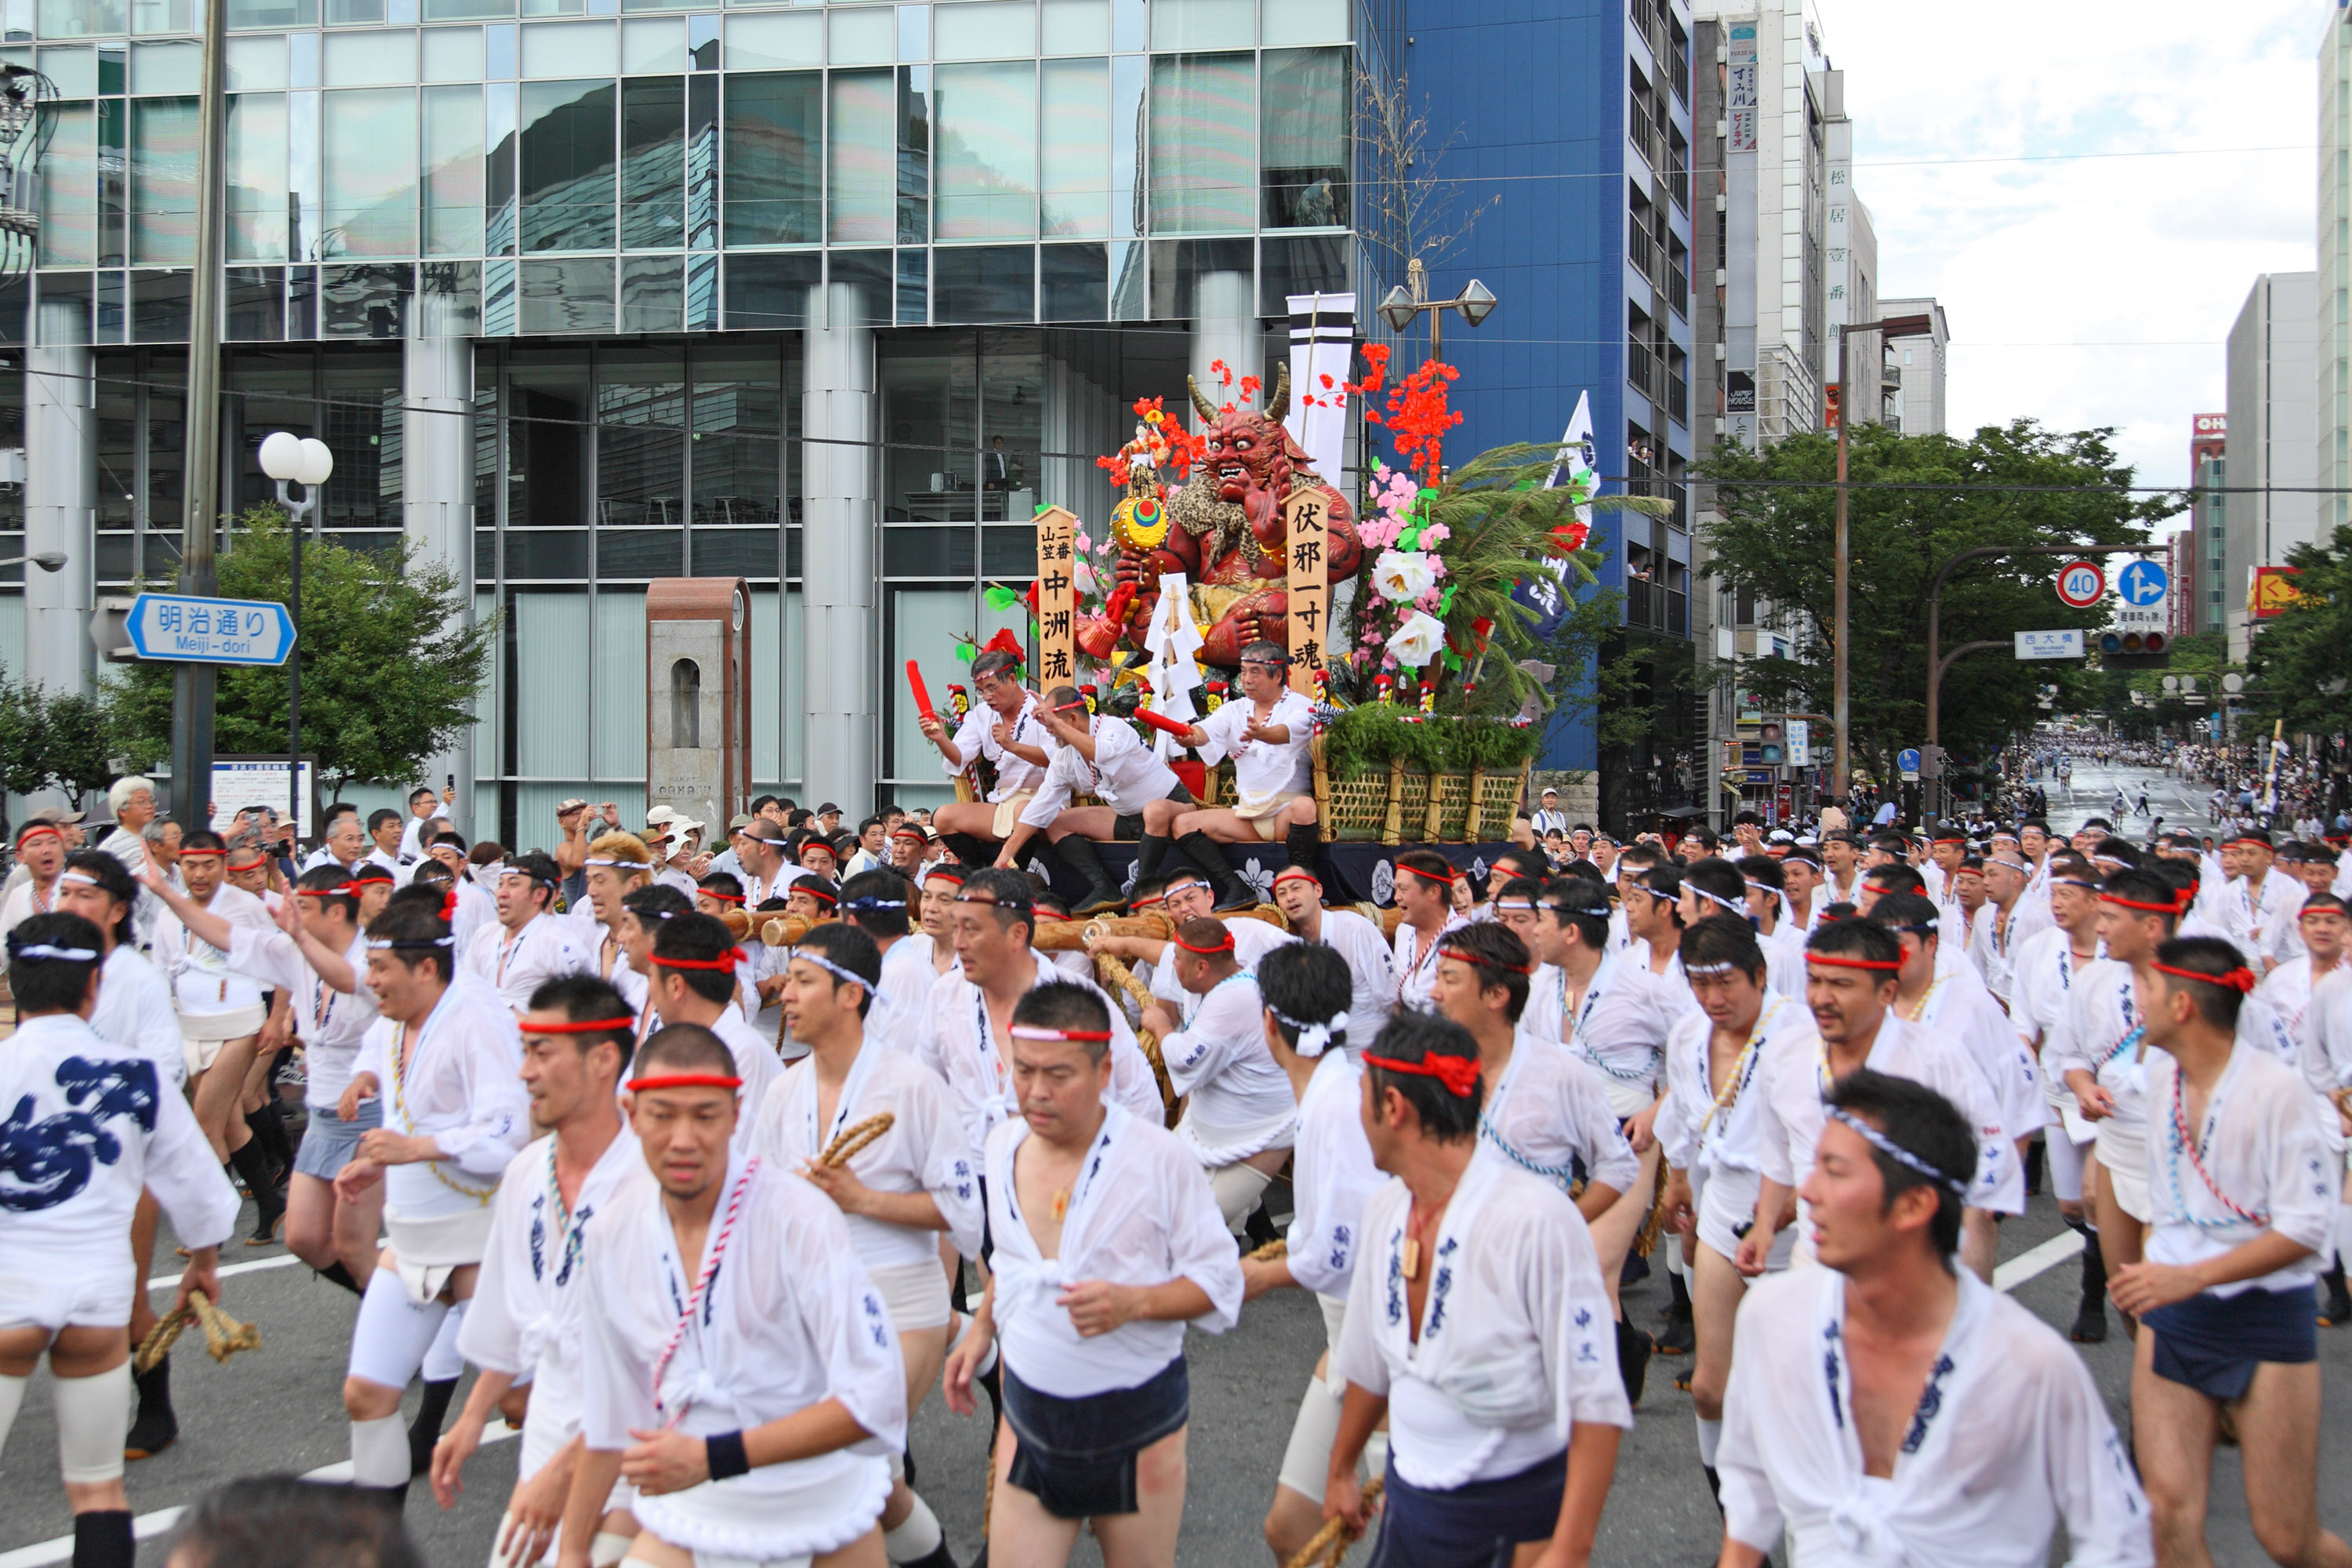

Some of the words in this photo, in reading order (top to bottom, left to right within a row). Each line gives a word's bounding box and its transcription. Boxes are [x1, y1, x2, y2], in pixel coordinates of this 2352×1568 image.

[1733, 67, 1745, 106] すみ川
[1727, 397, 1755, 405] HOUSE
[1041, 526, 1055, 560] 山笠
[1056, 526, 1071, 560] 二番
[1293, 503, 1323, 670] 伏邪一寸魂
[2068, 575, 2094, 594] 40
[159, 604, 265, 637] 明治通り
[1043, 569, 1071, 680] 中洲流
[176, 636, 251, 654] Meiji-dori
[2024, 633, 2073, 644] 西大橋
